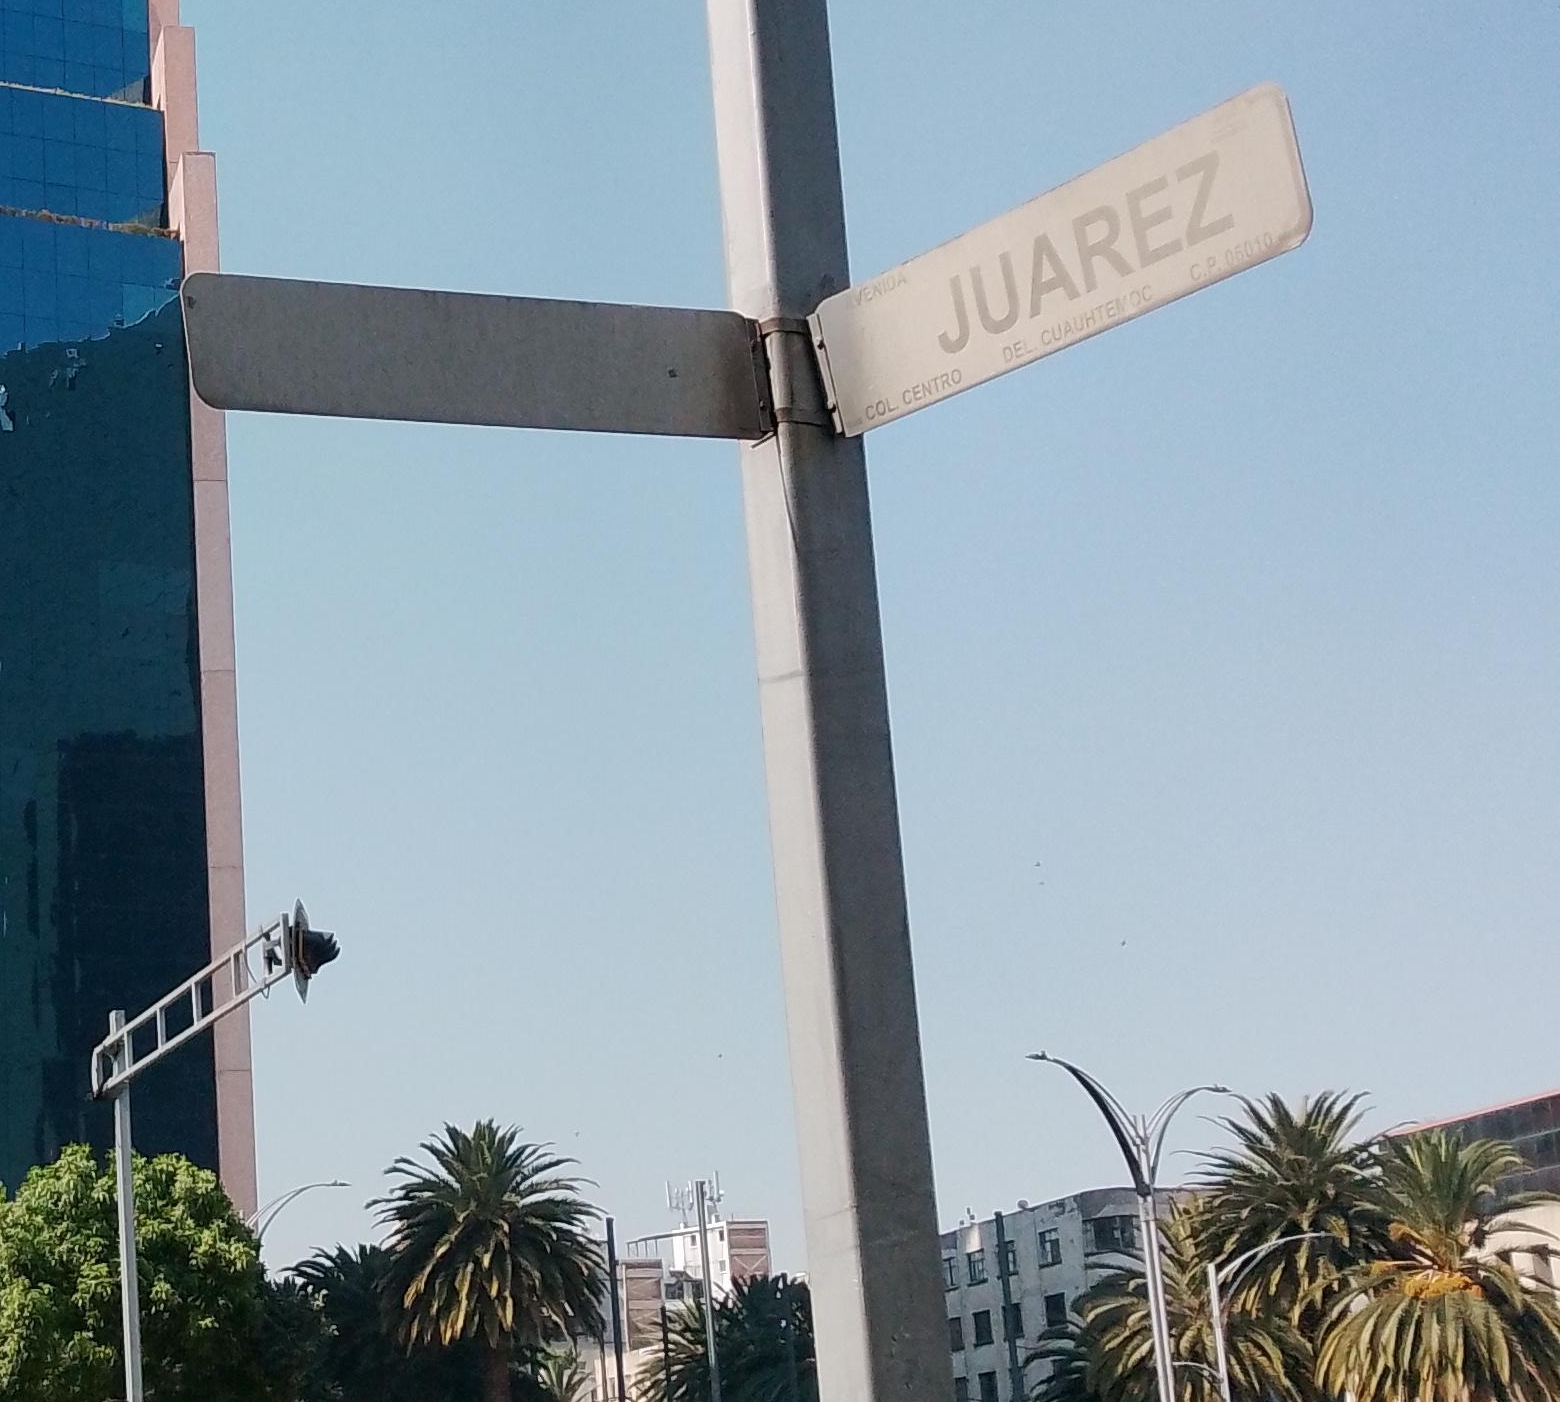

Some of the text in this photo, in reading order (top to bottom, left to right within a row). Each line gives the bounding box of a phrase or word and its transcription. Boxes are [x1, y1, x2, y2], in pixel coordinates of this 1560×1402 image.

[937, 149, 1234, 353] JUAREZ
[865, 400, 899, 421] COL.
[902, 369, 962, 405] CENTRO
